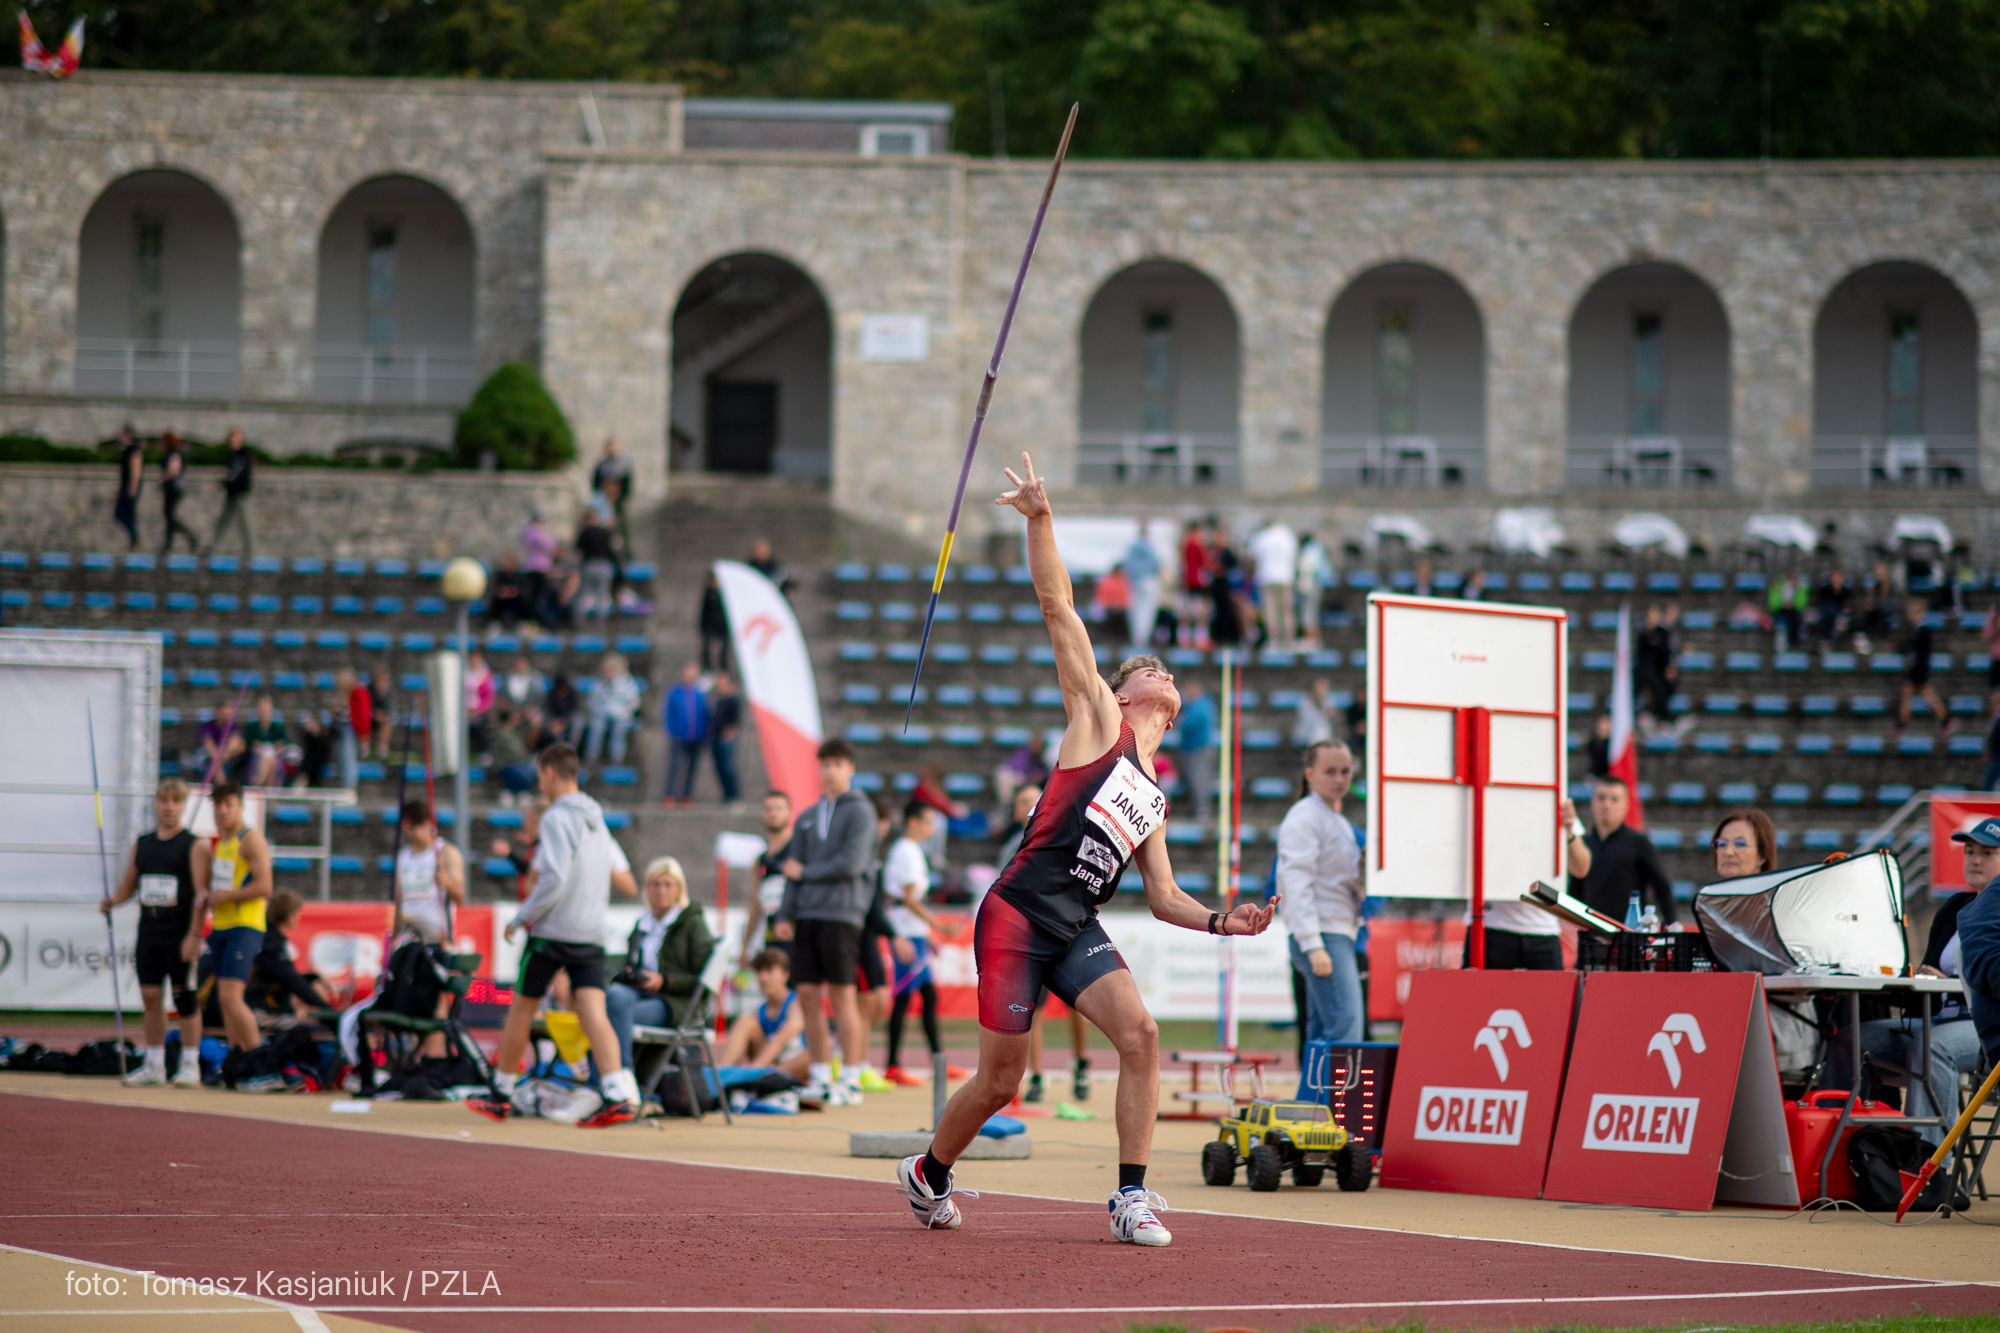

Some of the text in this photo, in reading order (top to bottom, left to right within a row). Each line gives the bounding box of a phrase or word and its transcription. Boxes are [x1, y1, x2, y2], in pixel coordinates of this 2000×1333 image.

[1122, 775, 1137, 791] ORLEN
[1111, 792, 1150, 836] JANAS
[1424, 1094, 1519, 1136] ORLEN
[1593, 1102, 1691, 1145] ORLEN
